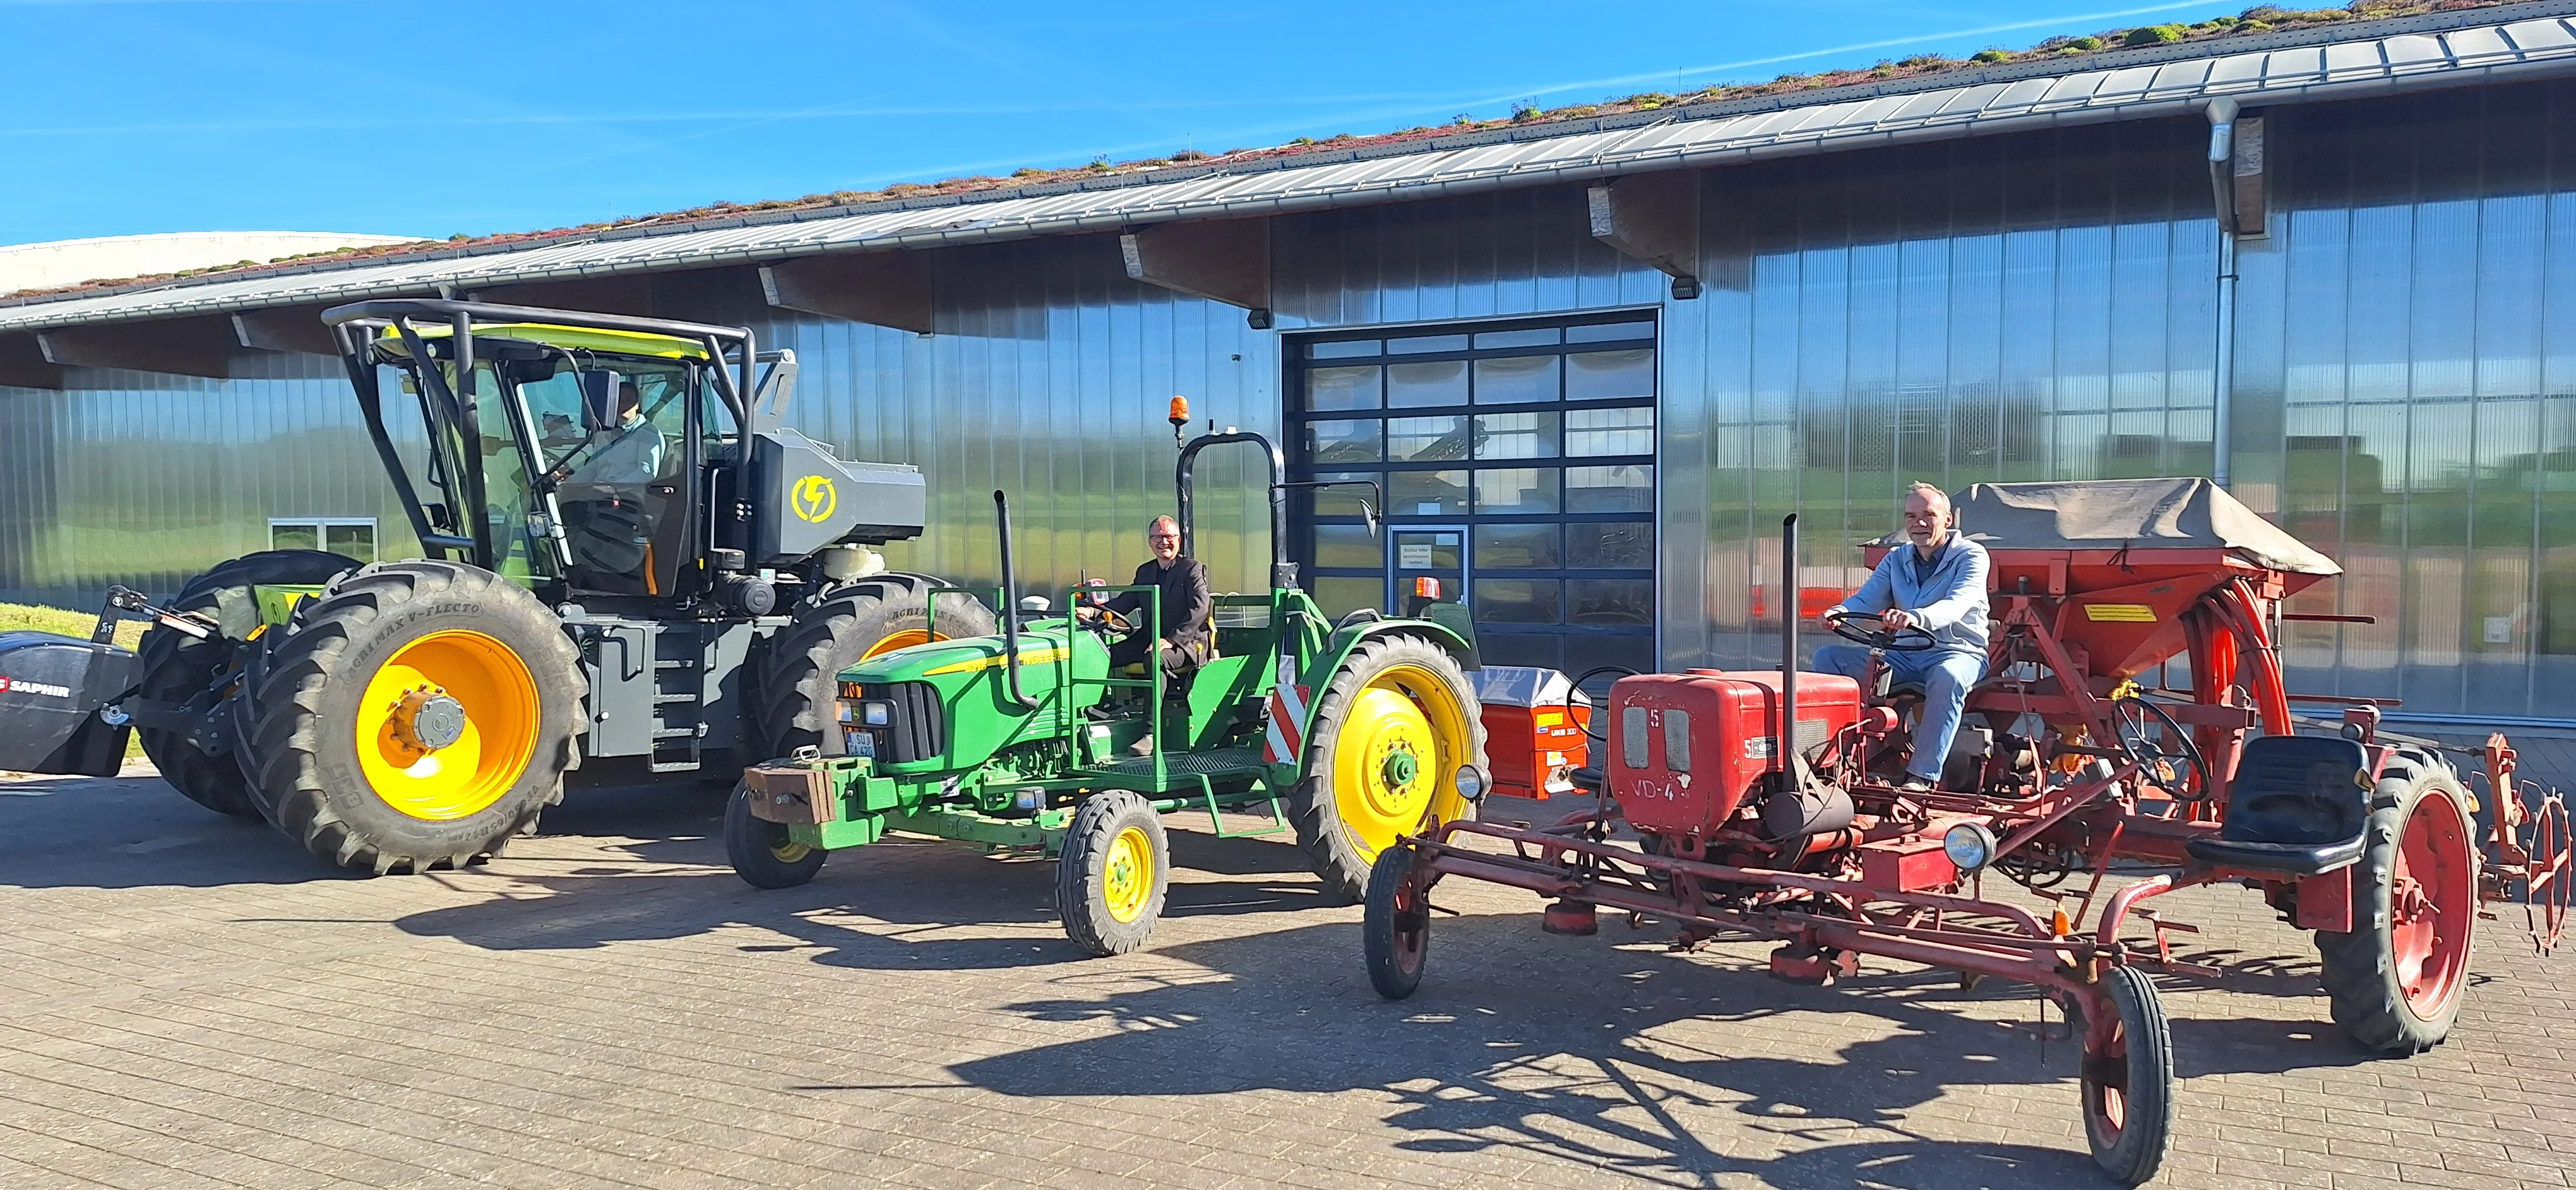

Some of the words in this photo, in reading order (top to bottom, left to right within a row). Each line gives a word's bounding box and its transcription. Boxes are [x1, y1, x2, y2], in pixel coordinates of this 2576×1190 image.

[9, 680, 69, 698] SAPHIR
[1650, 709, 1659, 727] 5
[856, 734, 865, 744] SU
[861, 746, 873, 756] 420
[1744, 740, 1751, 759] 5
[1630, 778, 1674, 801] VD-4
